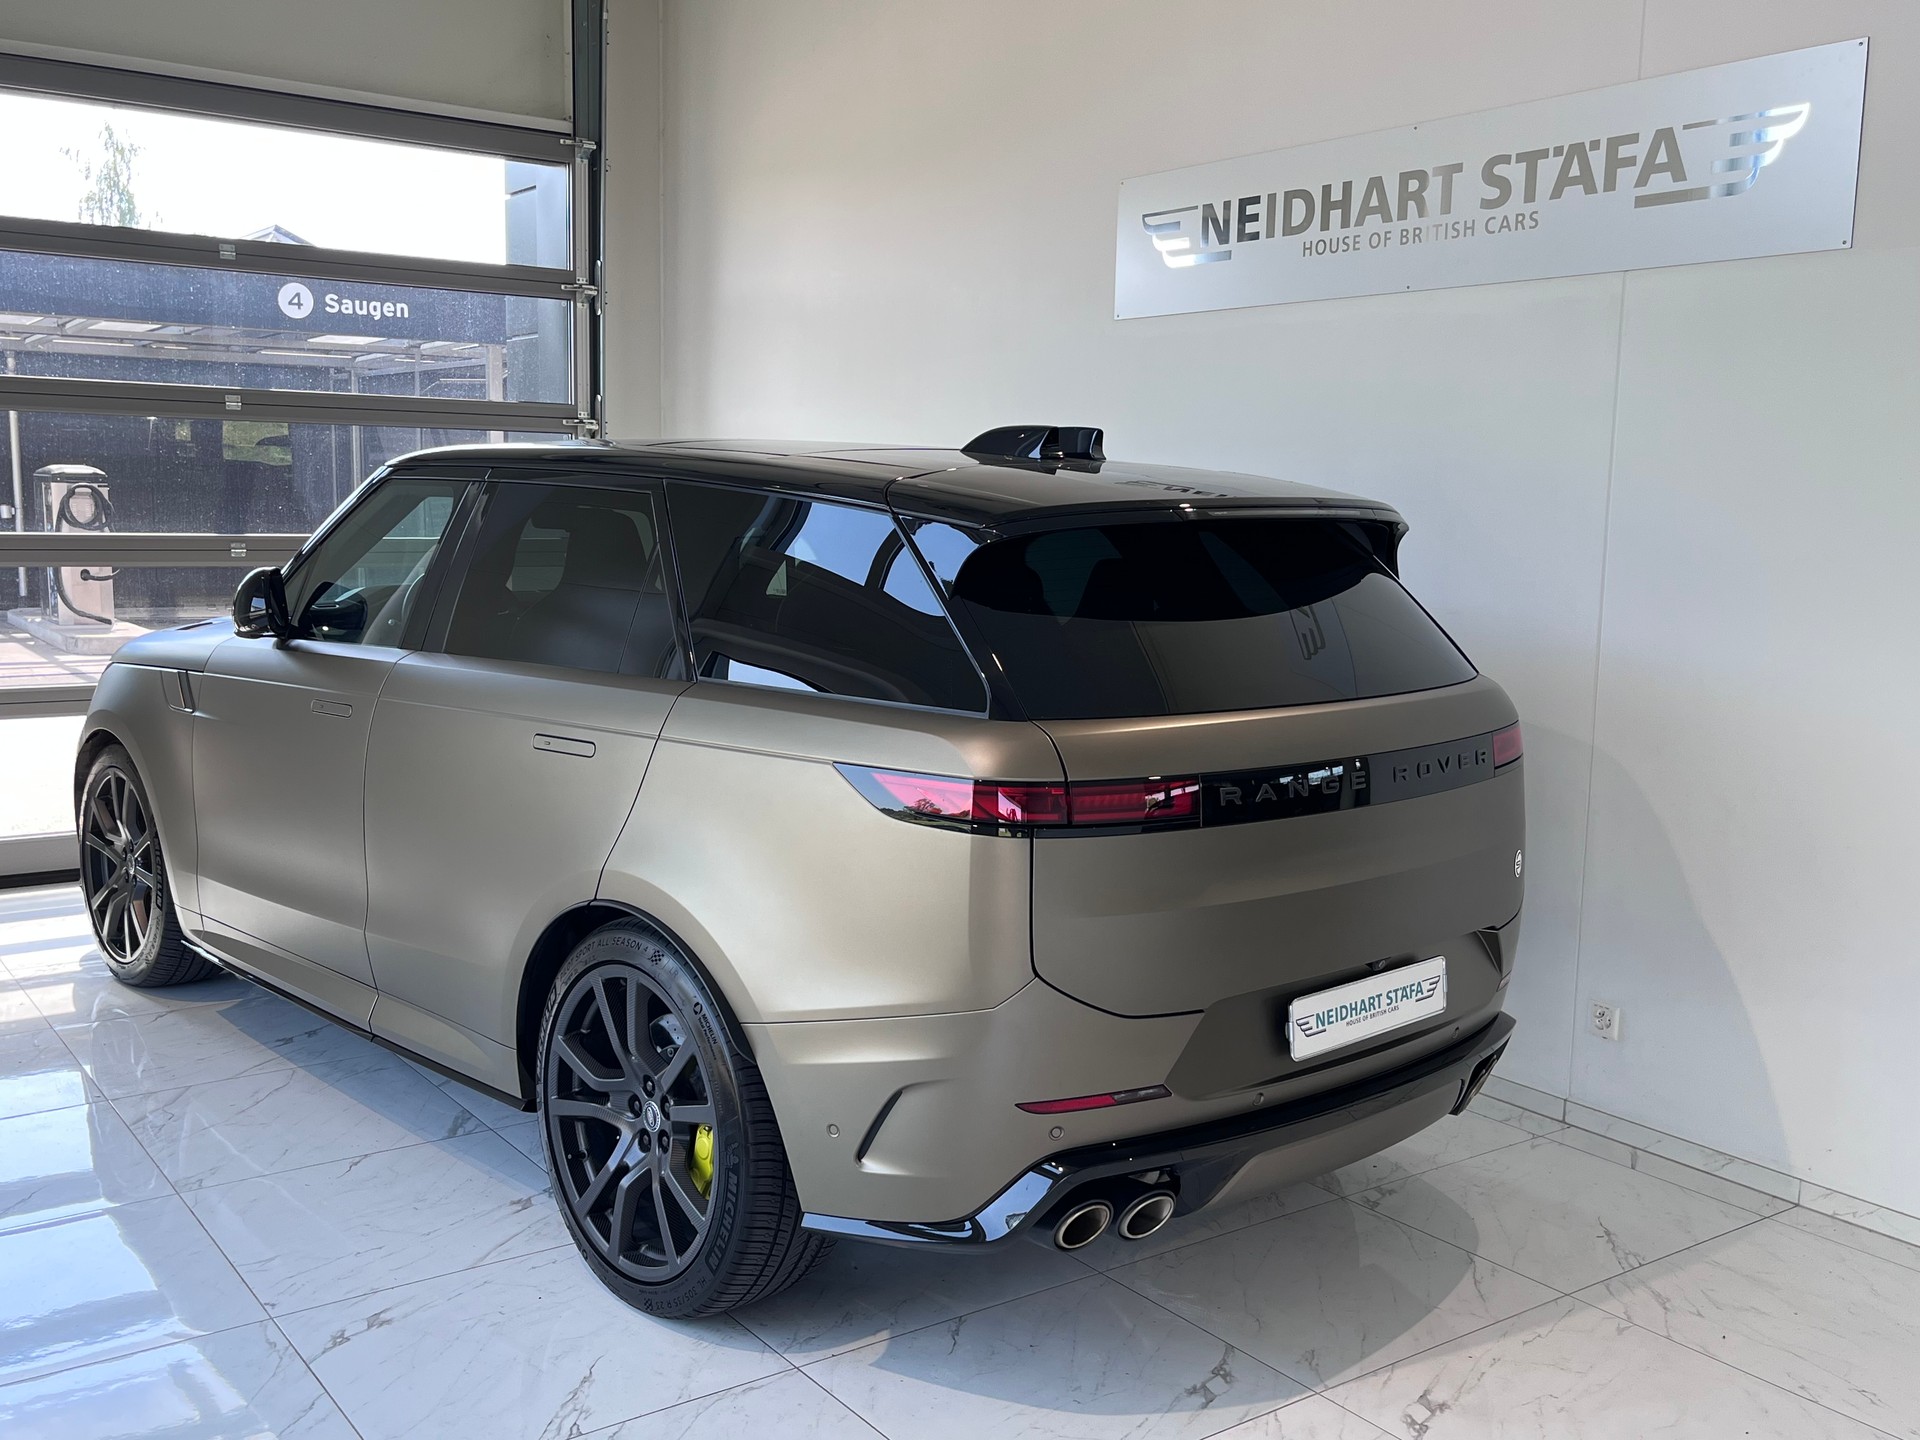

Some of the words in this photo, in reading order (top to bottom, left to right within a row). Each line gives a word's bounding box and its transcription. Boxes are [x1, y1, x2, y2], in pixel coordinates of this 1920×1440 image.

[1200, 162, 1464, 249] NEIDHART
[1480, 126, 1688, 210] STÄFA
[1302, 234, 1361, 258] HOUSE
[1368, 230, 1392, 250] OF
[1399, 219, 1475, 246] BRITISH
[1484, 210, 1540, 235] CARS
[287, 292, 304, 310] 4
[324, 293, 409, 321] Saugen
[1219, 770, 1367, 807] RANGE
[1392, 748, 1489, 784] ROVER
[575, 941, 596, 962] SPORT
[597, 938, 609, 947] ALL
[611, 936, 642, 950] SEASON
[1315, 992, 1383, 1029] NEIDHART
[1385, 980, 1424, 1007] STÄFA
[1346, 1016, 1361, 1027] HOUSE
[1362, 1014, 1369, 1022] OF
[1369, 1008, 1387, 1020] BRITISH
[1387, 1004, 1400, 1014] CARS
[701, 1013, 718, 1045] MICHELIN
[707, 1172, 738, 1272] MICHELIN
